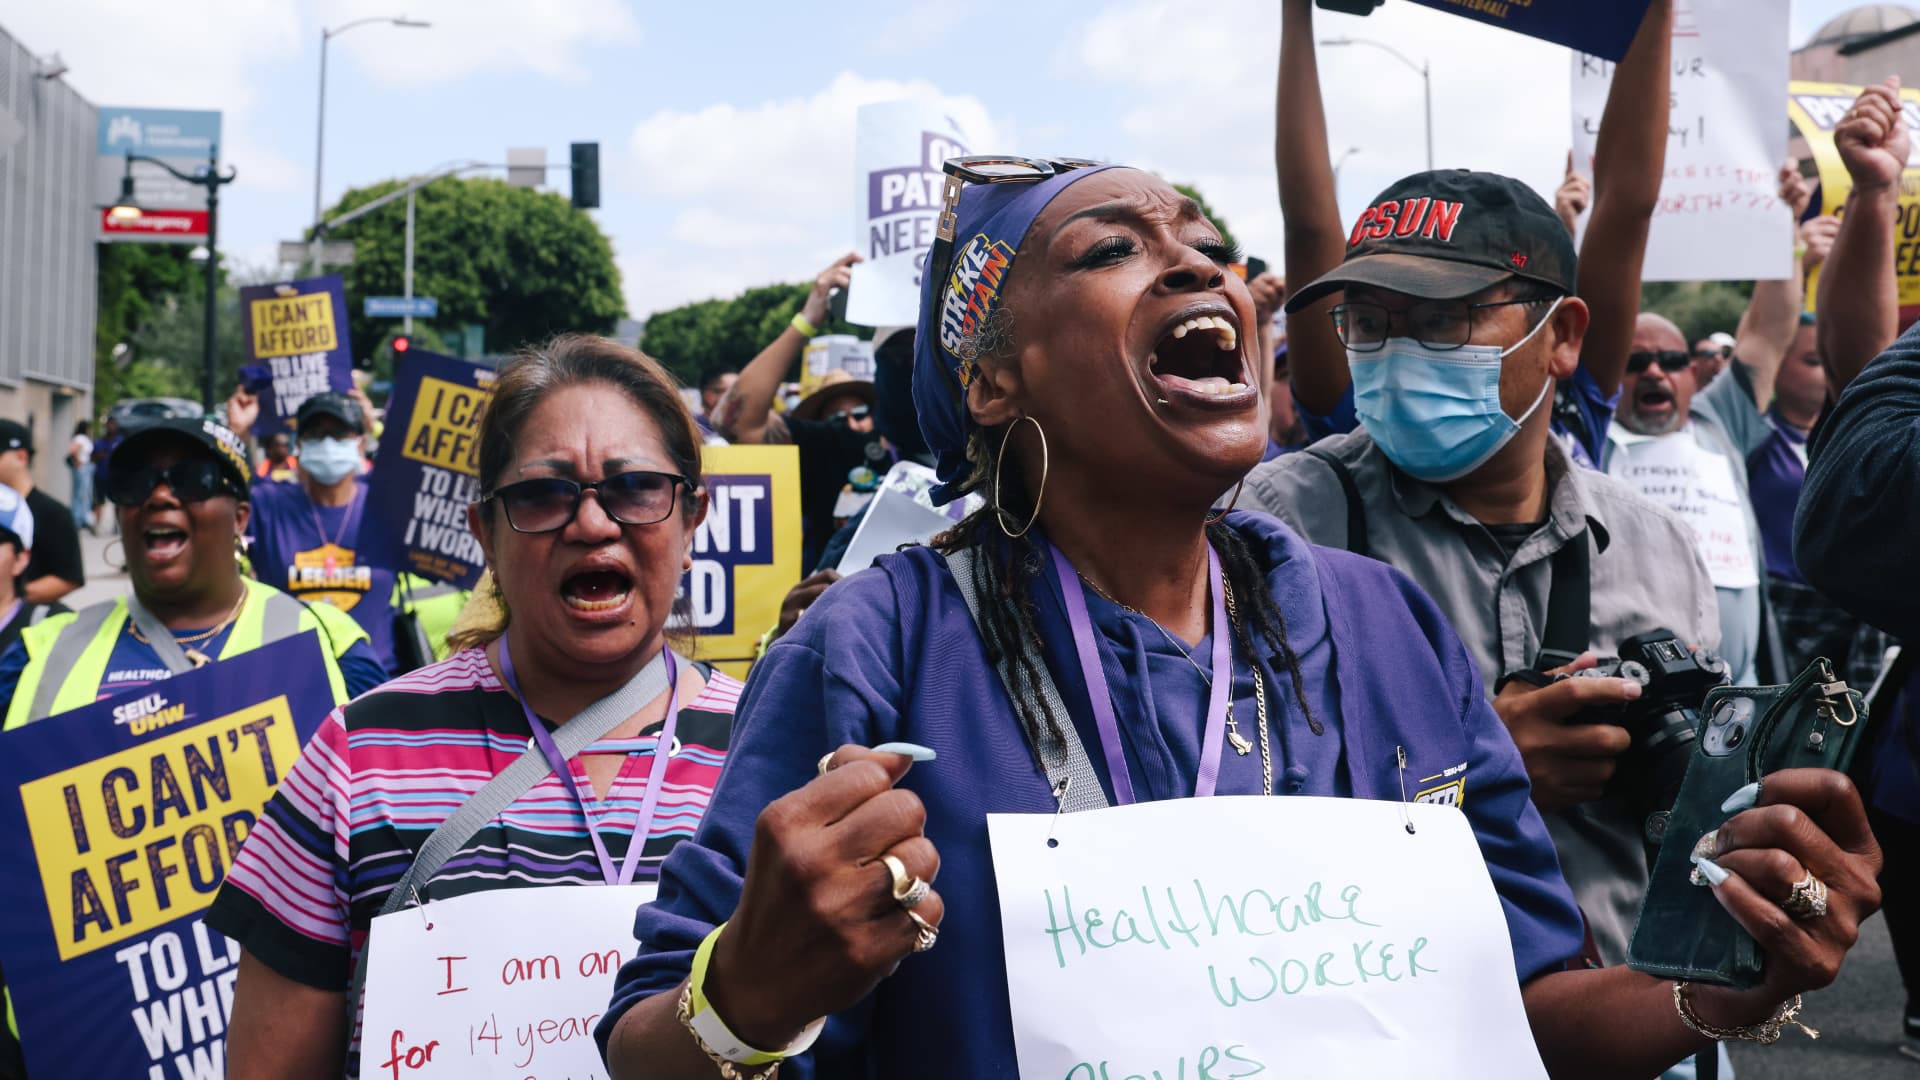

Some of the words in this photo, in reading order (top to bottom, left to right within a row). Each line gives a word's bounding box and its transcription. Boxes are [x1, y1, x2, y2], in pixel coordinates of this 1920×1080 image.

[881, 171, 947, 212] PAT
[870, 216, 939, 260] NEE
[1351, 197, 1464, 247] CSUN
[260, 305, 267, 326] I
[270, 299, 324, 325] CAN'T
[941, 238, 989, 355] STRIKE
[260, 326, 330, 351] AFFORD
[269, 356, 291, 378] TO
[292, 352, 329, 376] LIVE
[272, 375, 331, 397] WHERE
[431, 388, 445, 420] I
[411, 424, 480, 470] AFFO
[421, 466, 450, 498] TO
[404, 518, 418, 545] I
[413, 492, 472, 532] WHE
[692, 485, 764, 553] NT
[107, 668, 172, 683] HEALTHCA
[129, 703, 185, 736] UHW
[63, 783, 91, 855] I
[101, 715, 278, 840] CAN'T
[69, 808, 257, 944] AFFOR
[115, 930, 189, 1003] TO
[436, 955, 469, 996] I
[502, 953, 561, 986] am
[578, 948, 622, 979] an
[1207, 936, 1439, 1008] WORKER
[380, 1029, 441, 1080] for
[469, 1012, 503, 1056] 14
[514, 1013, 600, 1068] year
